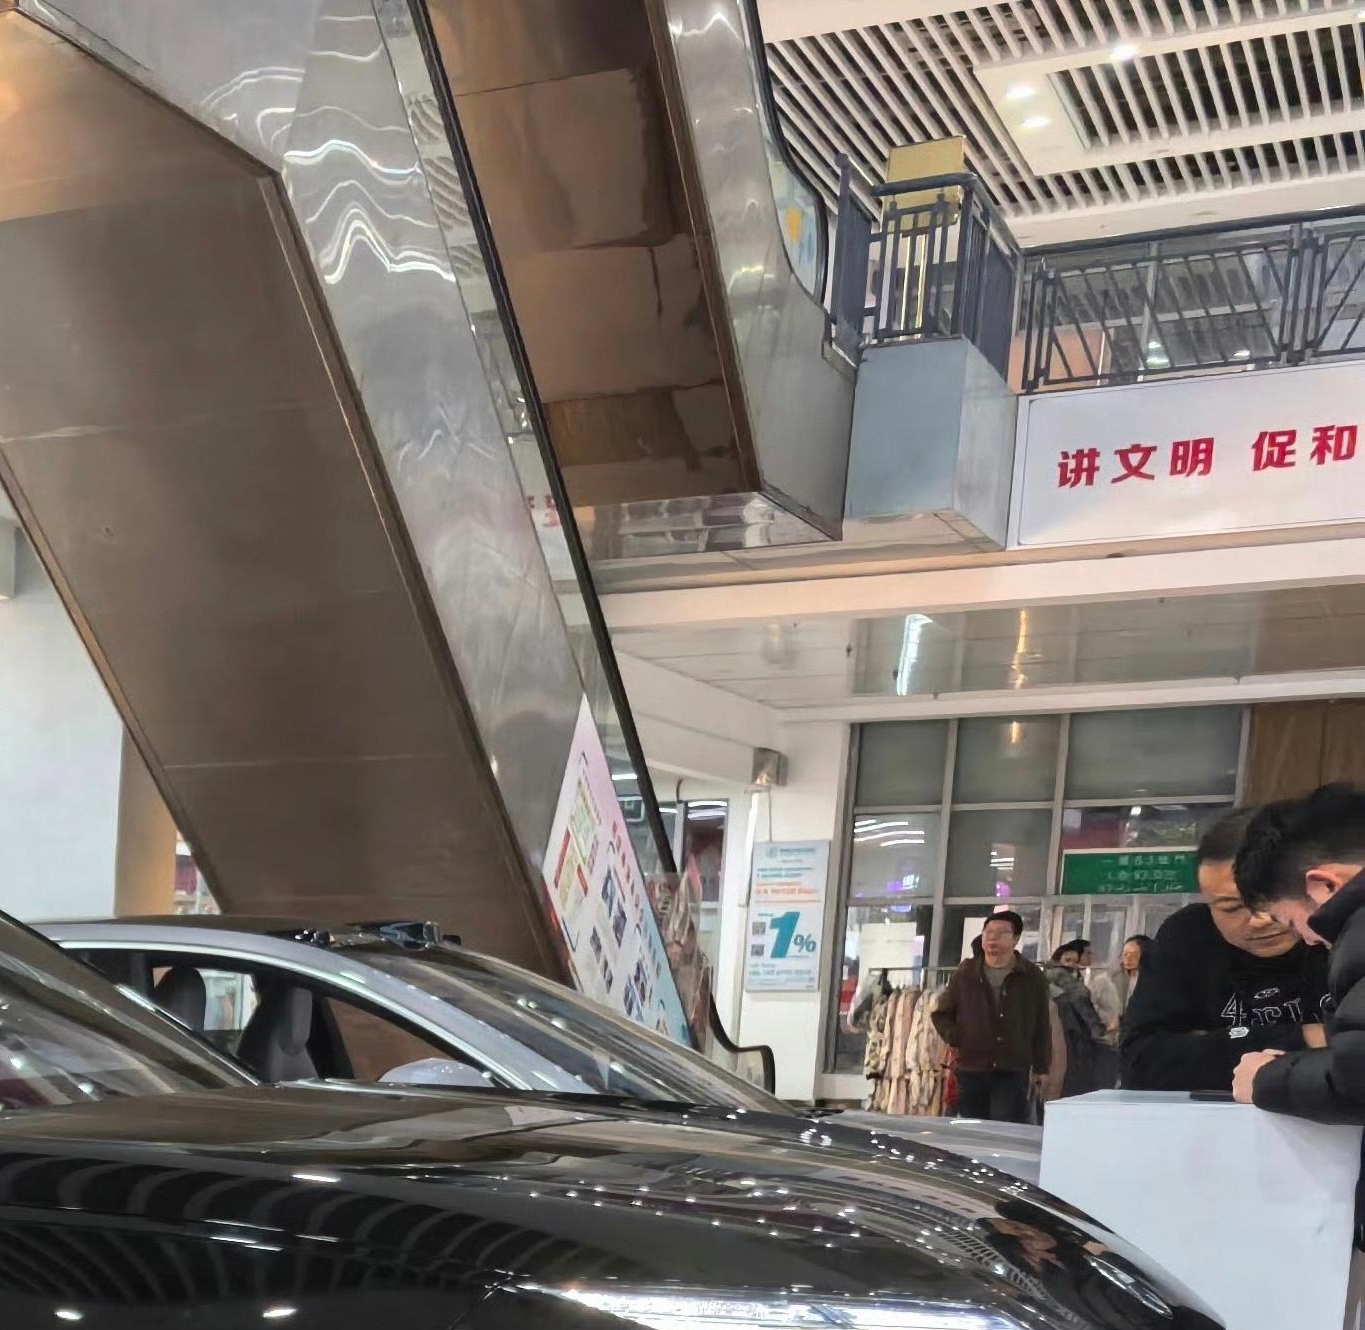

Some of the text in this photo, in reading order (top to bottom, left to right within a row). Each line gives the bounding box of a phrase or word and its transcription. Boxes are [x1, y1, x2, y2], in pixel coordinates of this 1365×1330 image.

[1057, 424, 1358, 488] 讲文明 促和
[769, 911, 817, 959] 1%
